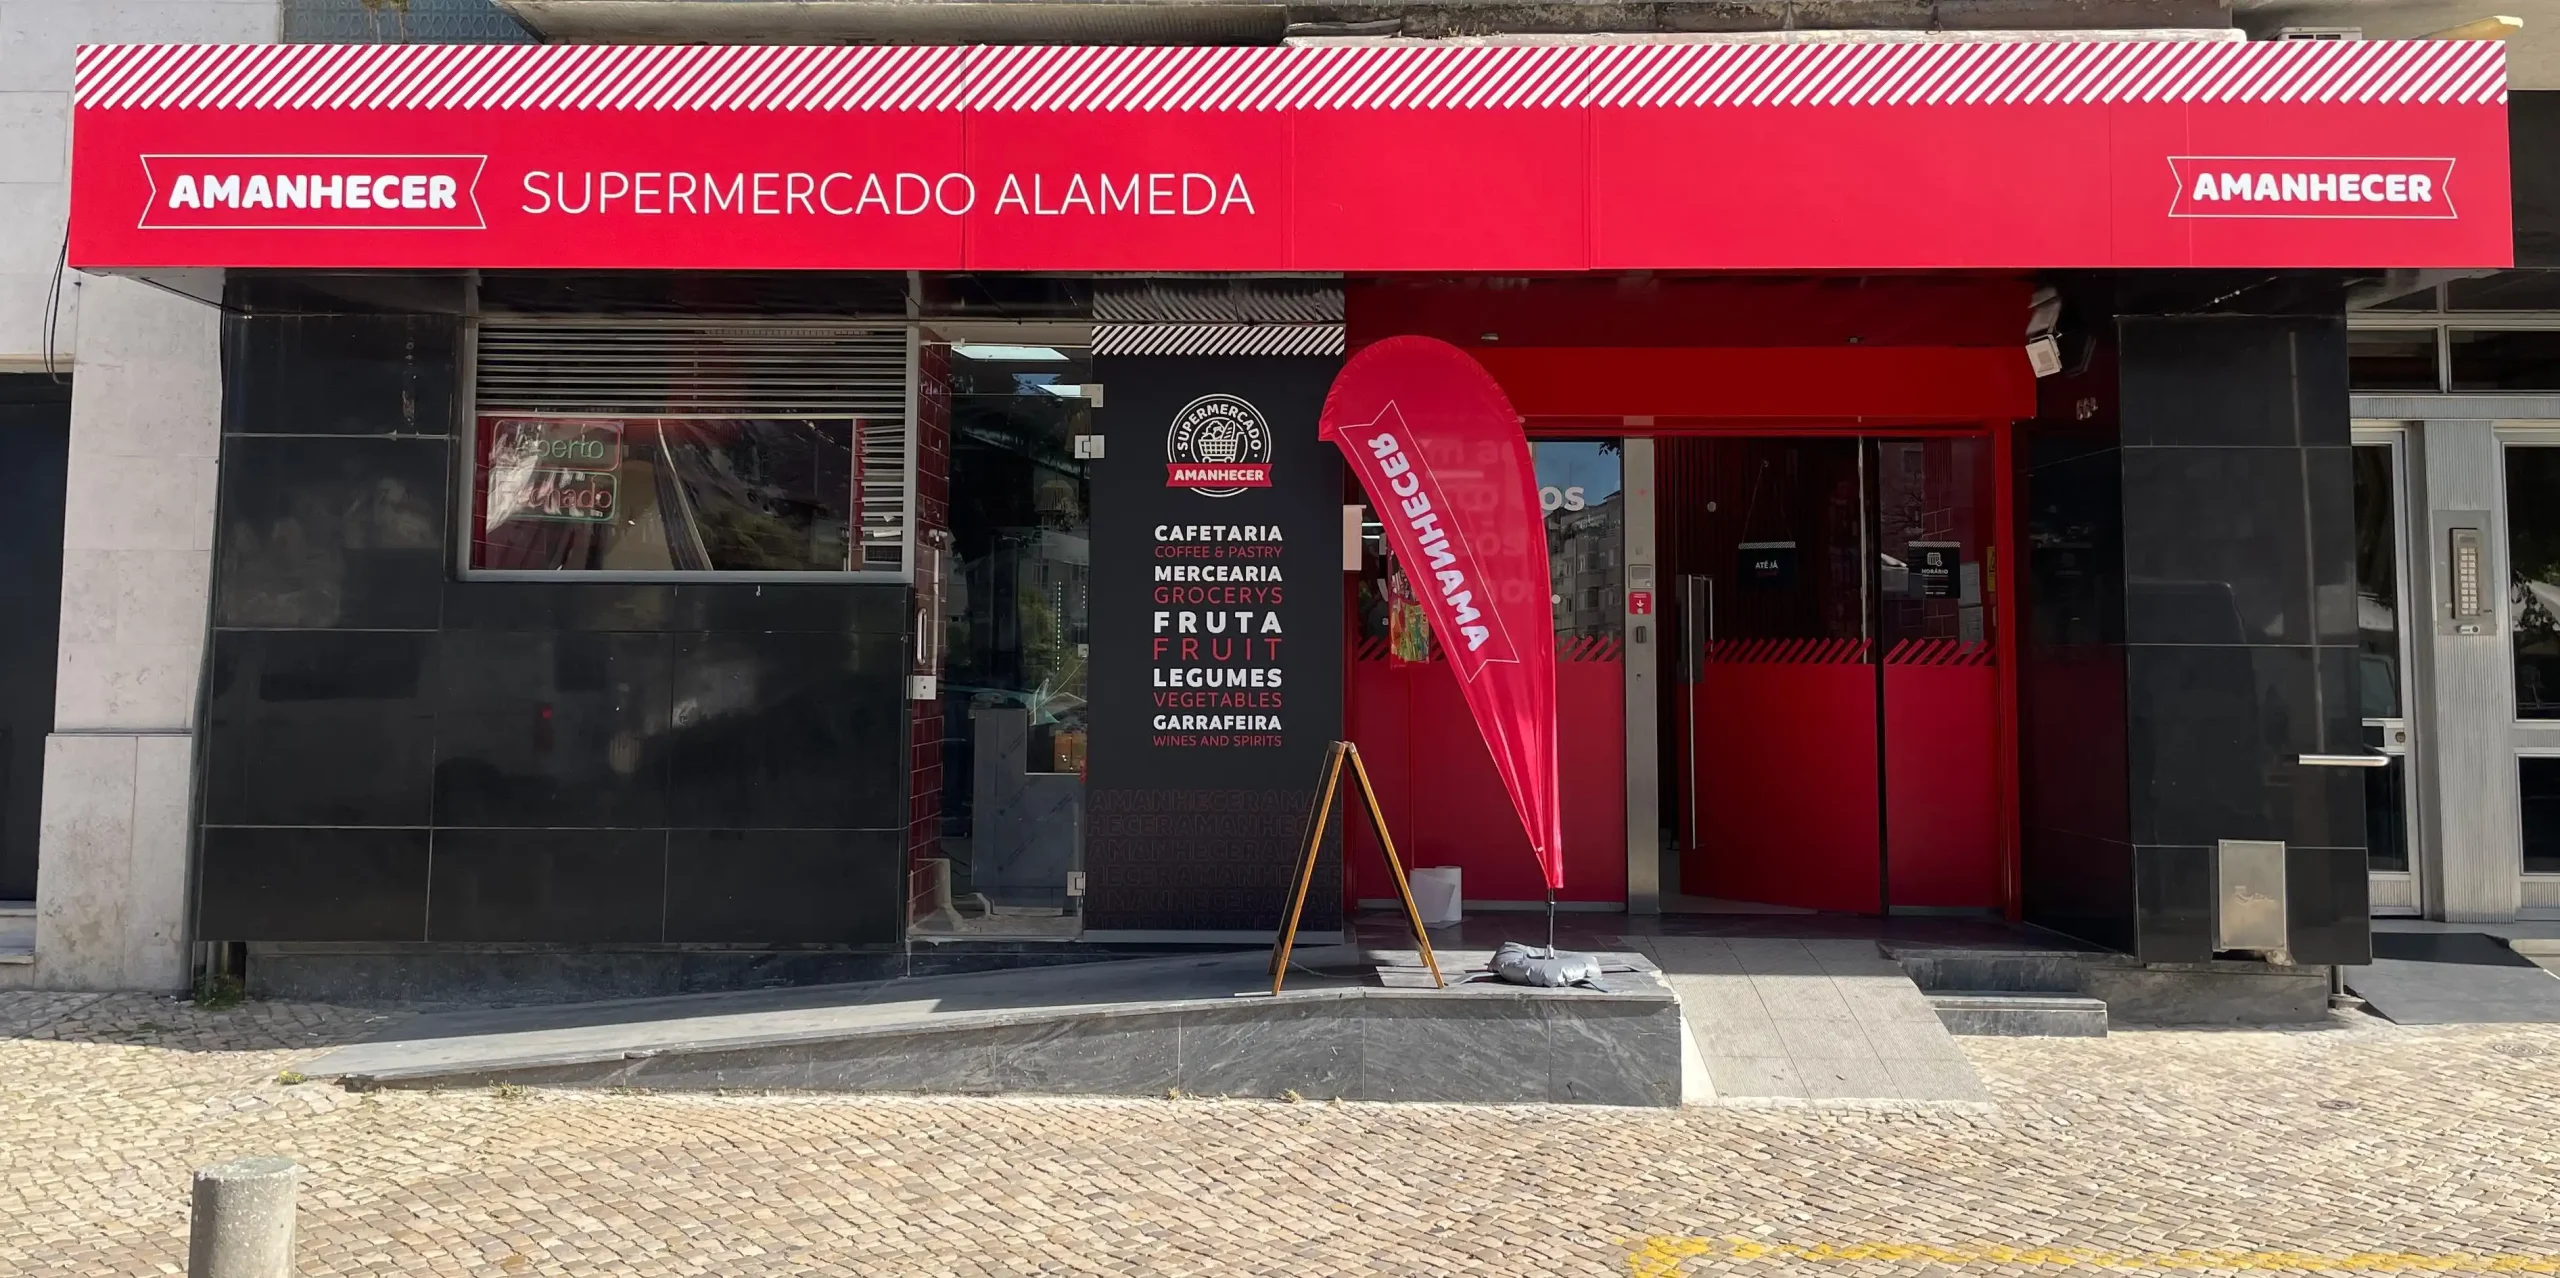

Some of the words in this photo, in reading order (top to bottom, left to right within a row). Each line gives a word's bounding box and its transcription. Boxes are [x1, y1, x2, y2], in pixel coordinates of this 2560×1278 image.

[168, 174, 457, 209] AMANHECER
[522, 170, 976, 216] SUPERMERCADO
[994, 172, 1256, 216] ALAMEDA
[2192, 172, 2433, 203] AMANHECER
[1177, 403, 1262, 451] SUPERMERCADO
[1174, 469, 1264, 481] AMANHECER
[1154, 525, 1283, 541] CAFETARIA
[1155, 546, 1210, 558] COFFEE
[1214, 546, 1224, 558] &
[1228, 546, 1283, 558] PASTRY
[1154, 565, 1283, 582] MERCEARIA
[1154, 586, 1283, 604] GROCERYS
[1154, 611, 1283, 634] FRUTA
[1153, 638, 1282, 661] FRUIT
[1153, 668, 1282, 687] LEGUMES
[1153, 692, 1282, 708] VEGETABLES
[1153, 714, 1282, 731] GARRAFEIRA
[1153, 735, 1197, 747] WINES
[1200, 735, 1230, 747] AND
[1233, 735, 1282, 747] SPIRITS
